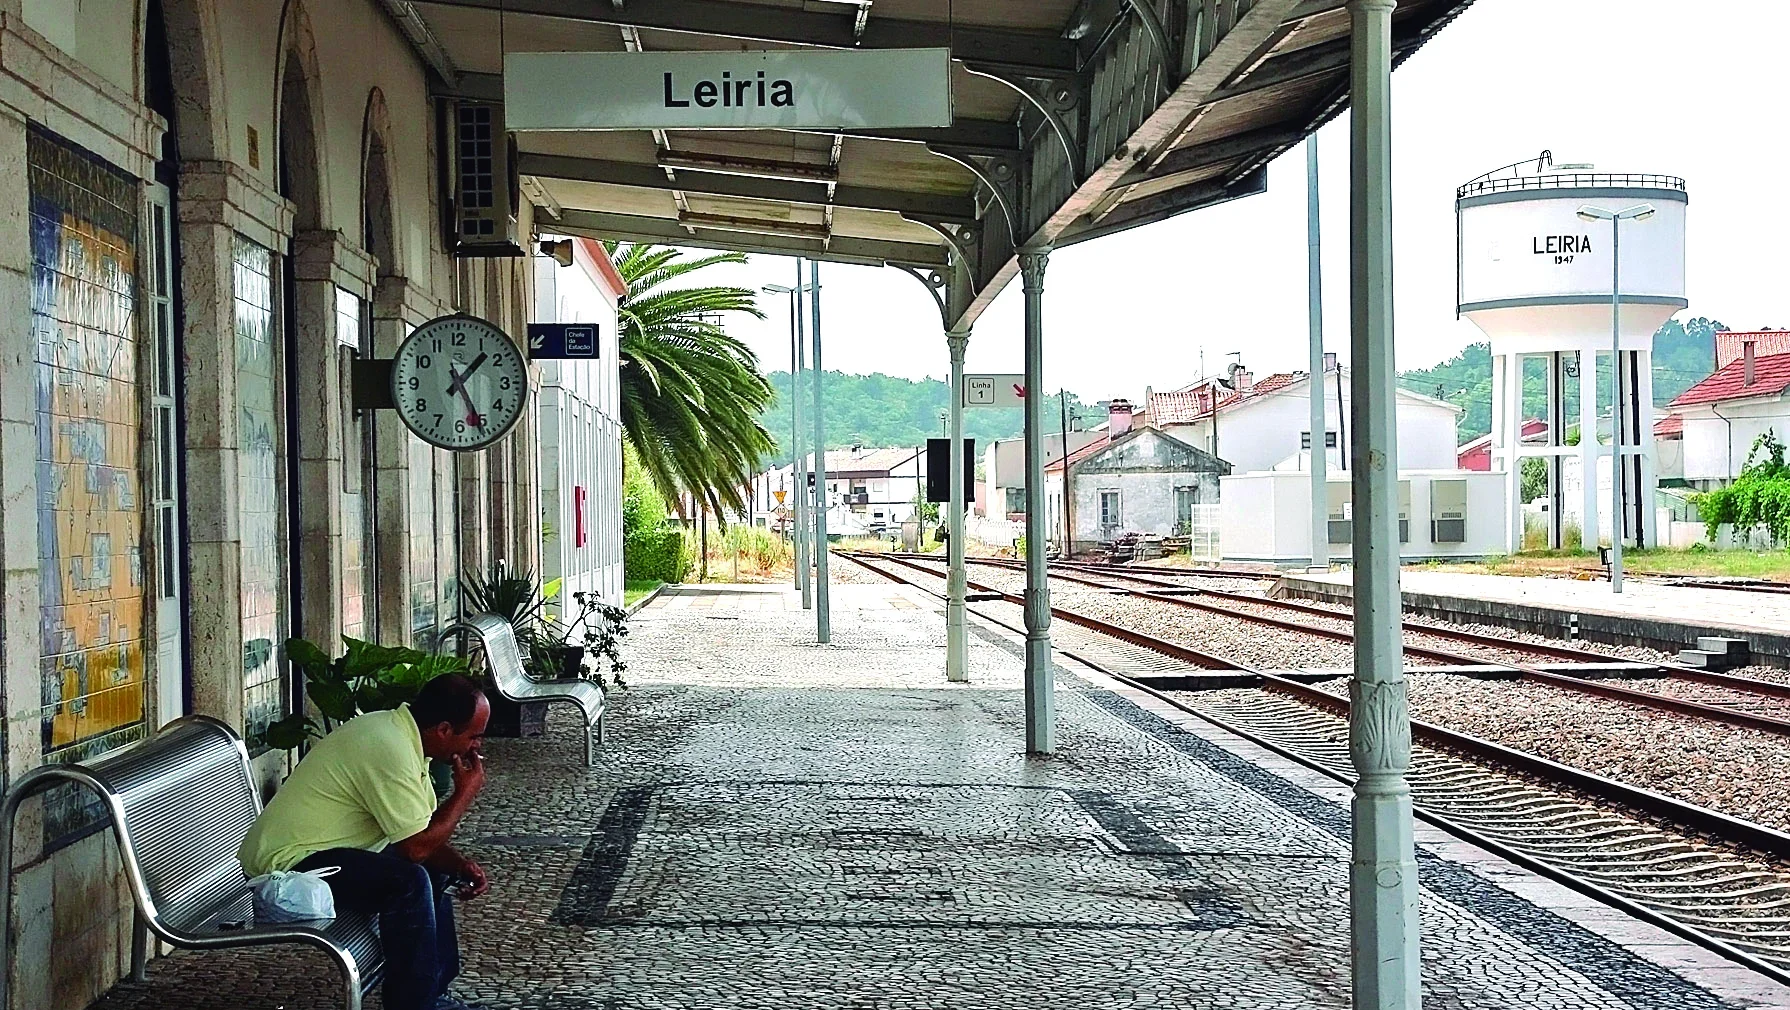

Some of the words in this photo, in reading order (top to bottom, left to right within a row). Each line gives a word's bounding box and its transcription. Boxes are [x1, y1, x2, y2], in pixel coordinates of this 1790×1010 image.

[664, 71, 795, 108] Leiria
[1533, 235, 1592, 254] LEIRIA
[1554, 255, 1574, 264] 1947
[451, 332, 466, 346] 12
[479, 338, 483, 351] 1
[432, 340, 442, 353] 11
[415, 355, 431, 369] 10
[492, 353, 503, 367] 2
[408, 376, 419, 390] 9
[500, 376, 510, 390] 3
[978, 390, 983, 398] 1
[415, 398, 427, 412] 8
[492, 398, 503, 411] 4
[433, 414, 443, 427] 7
[454, 420, 465, 433] 6
[479, 414, 488, 427] 5
